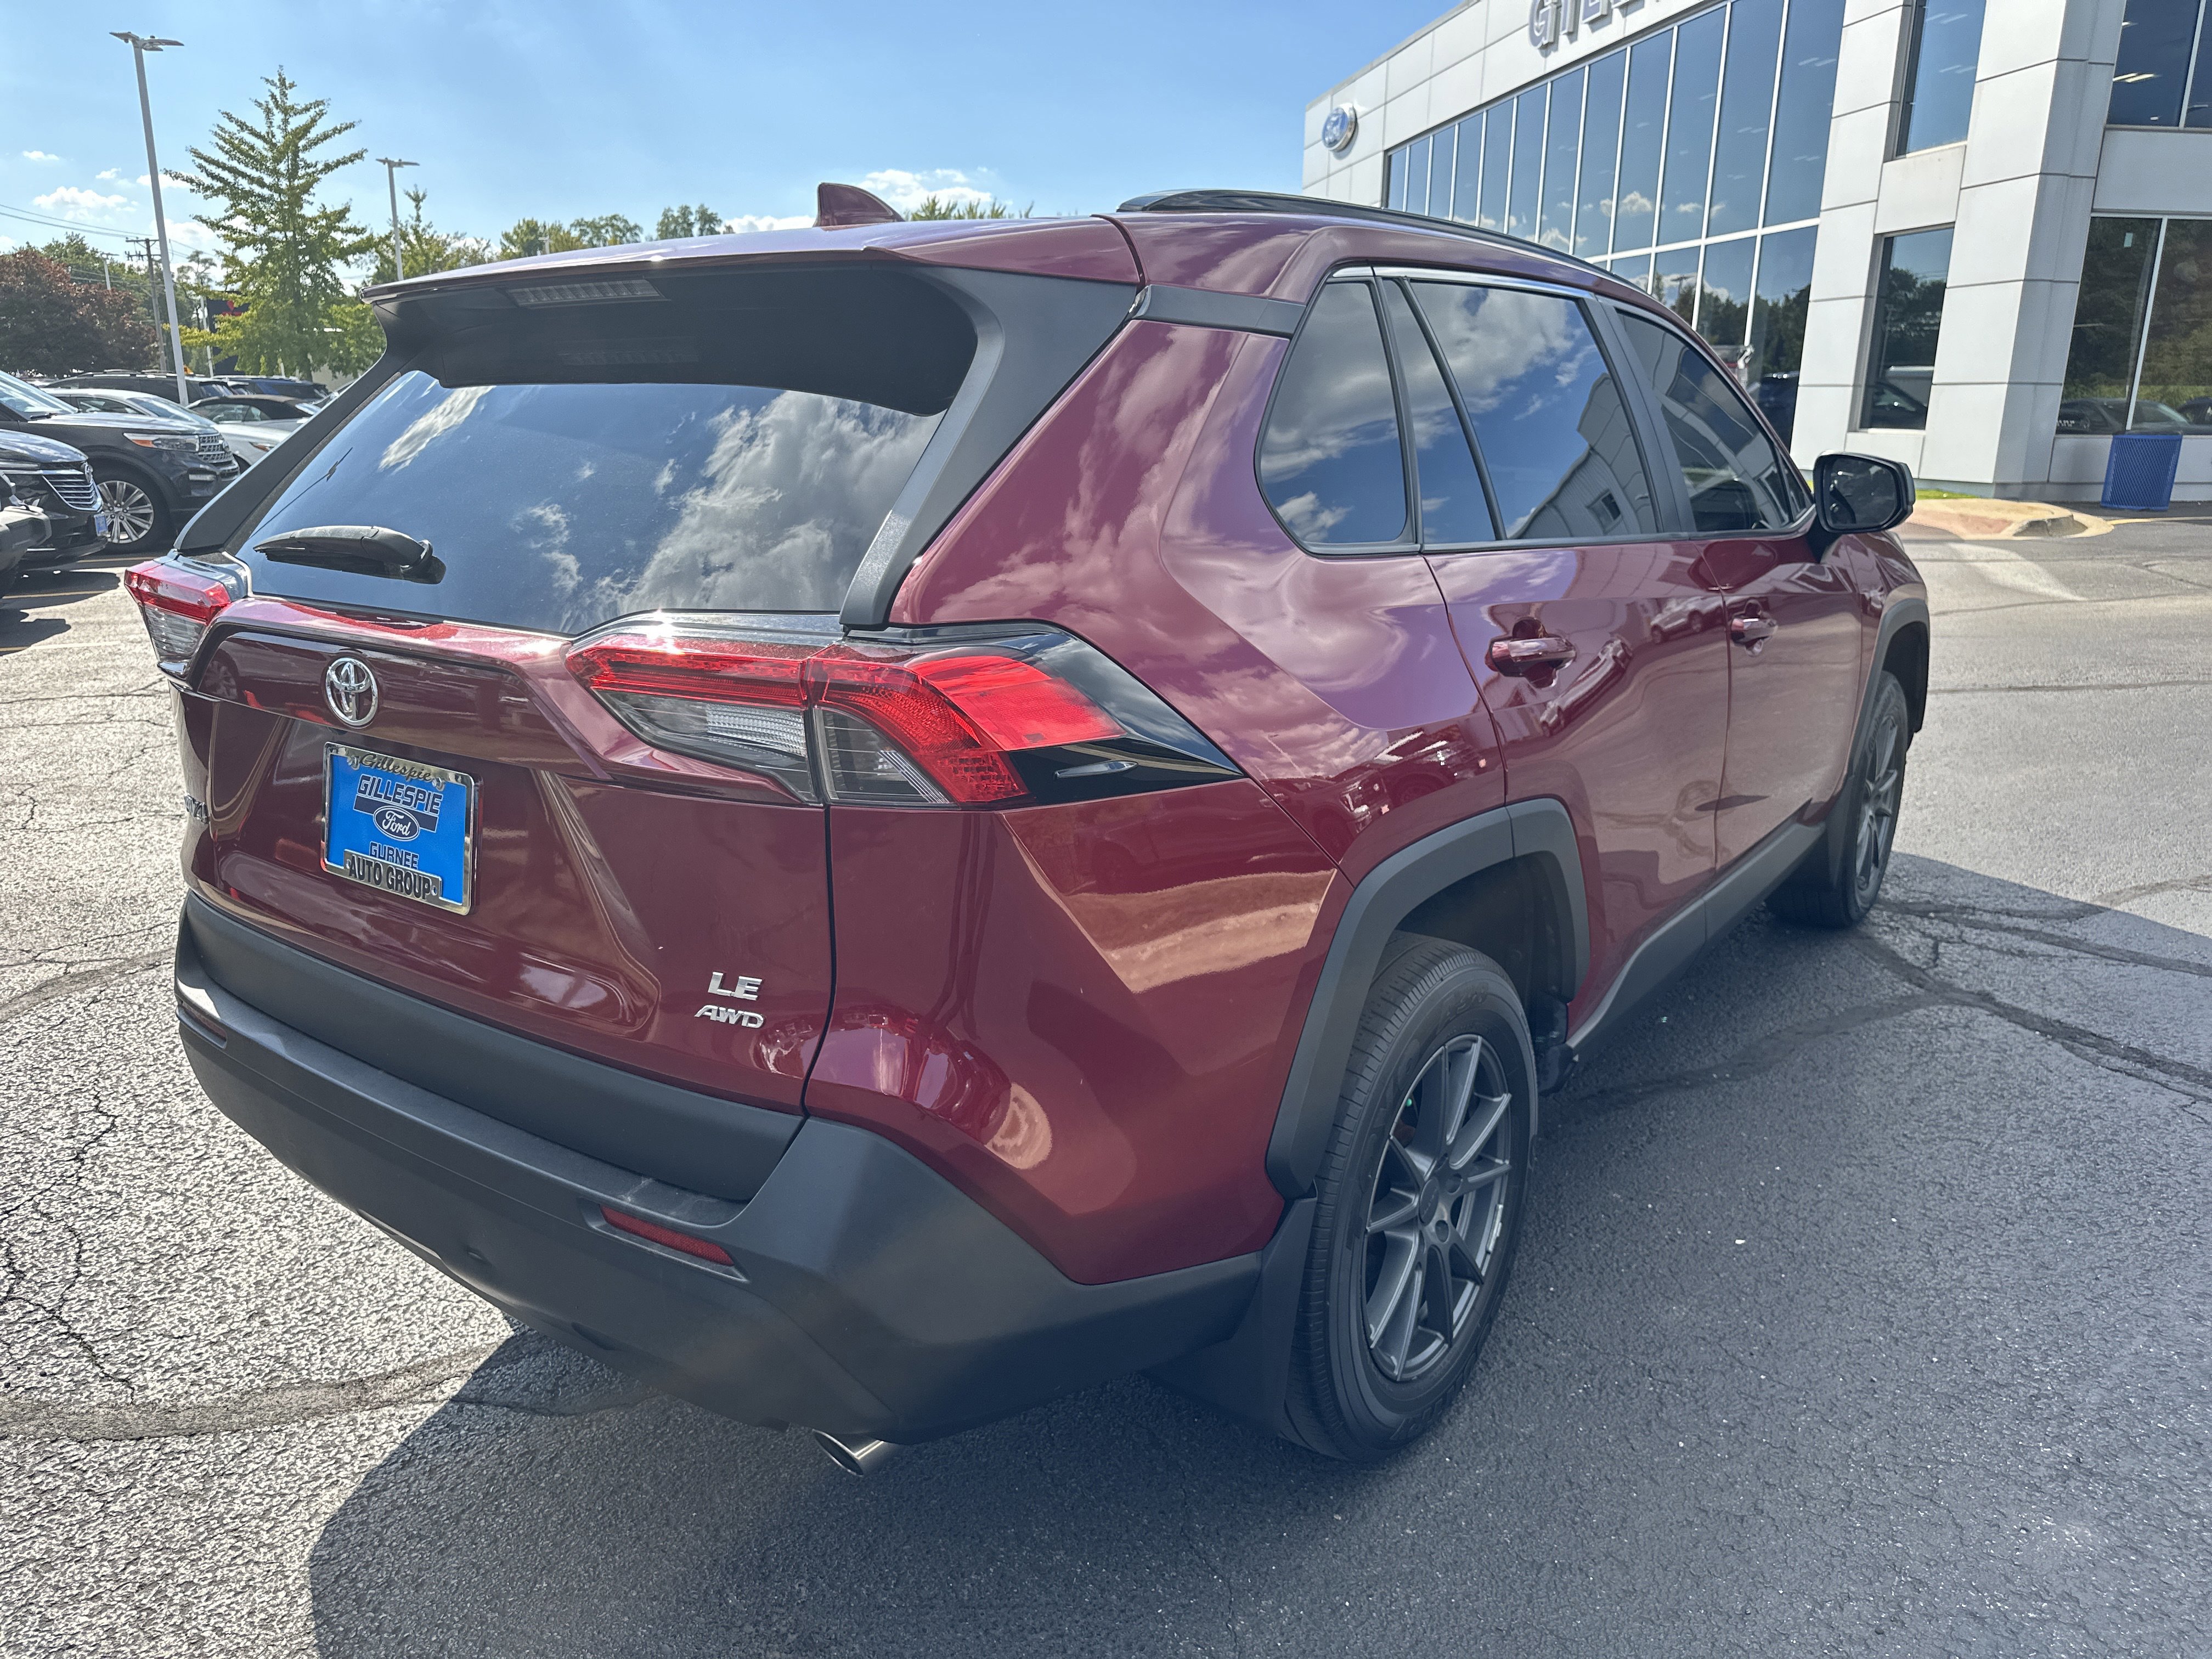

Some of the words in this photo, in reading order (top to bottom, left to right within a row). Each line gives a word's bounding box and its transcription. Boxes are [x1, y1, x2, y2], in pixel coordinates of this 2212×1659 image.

[360, 753, 432, 782] Gillespie
[357, 774, 443, 815] GILLESPIE
[382, 810, 411, 837] Ford
[369, 840, 420, 870] GURNEE
[348, 854, 384, 886] AUTO
[386, 865, 432, 900] GROUP
[708, 971, 763, 1001] LE
[693, 1005, 764, 1029] AWD
